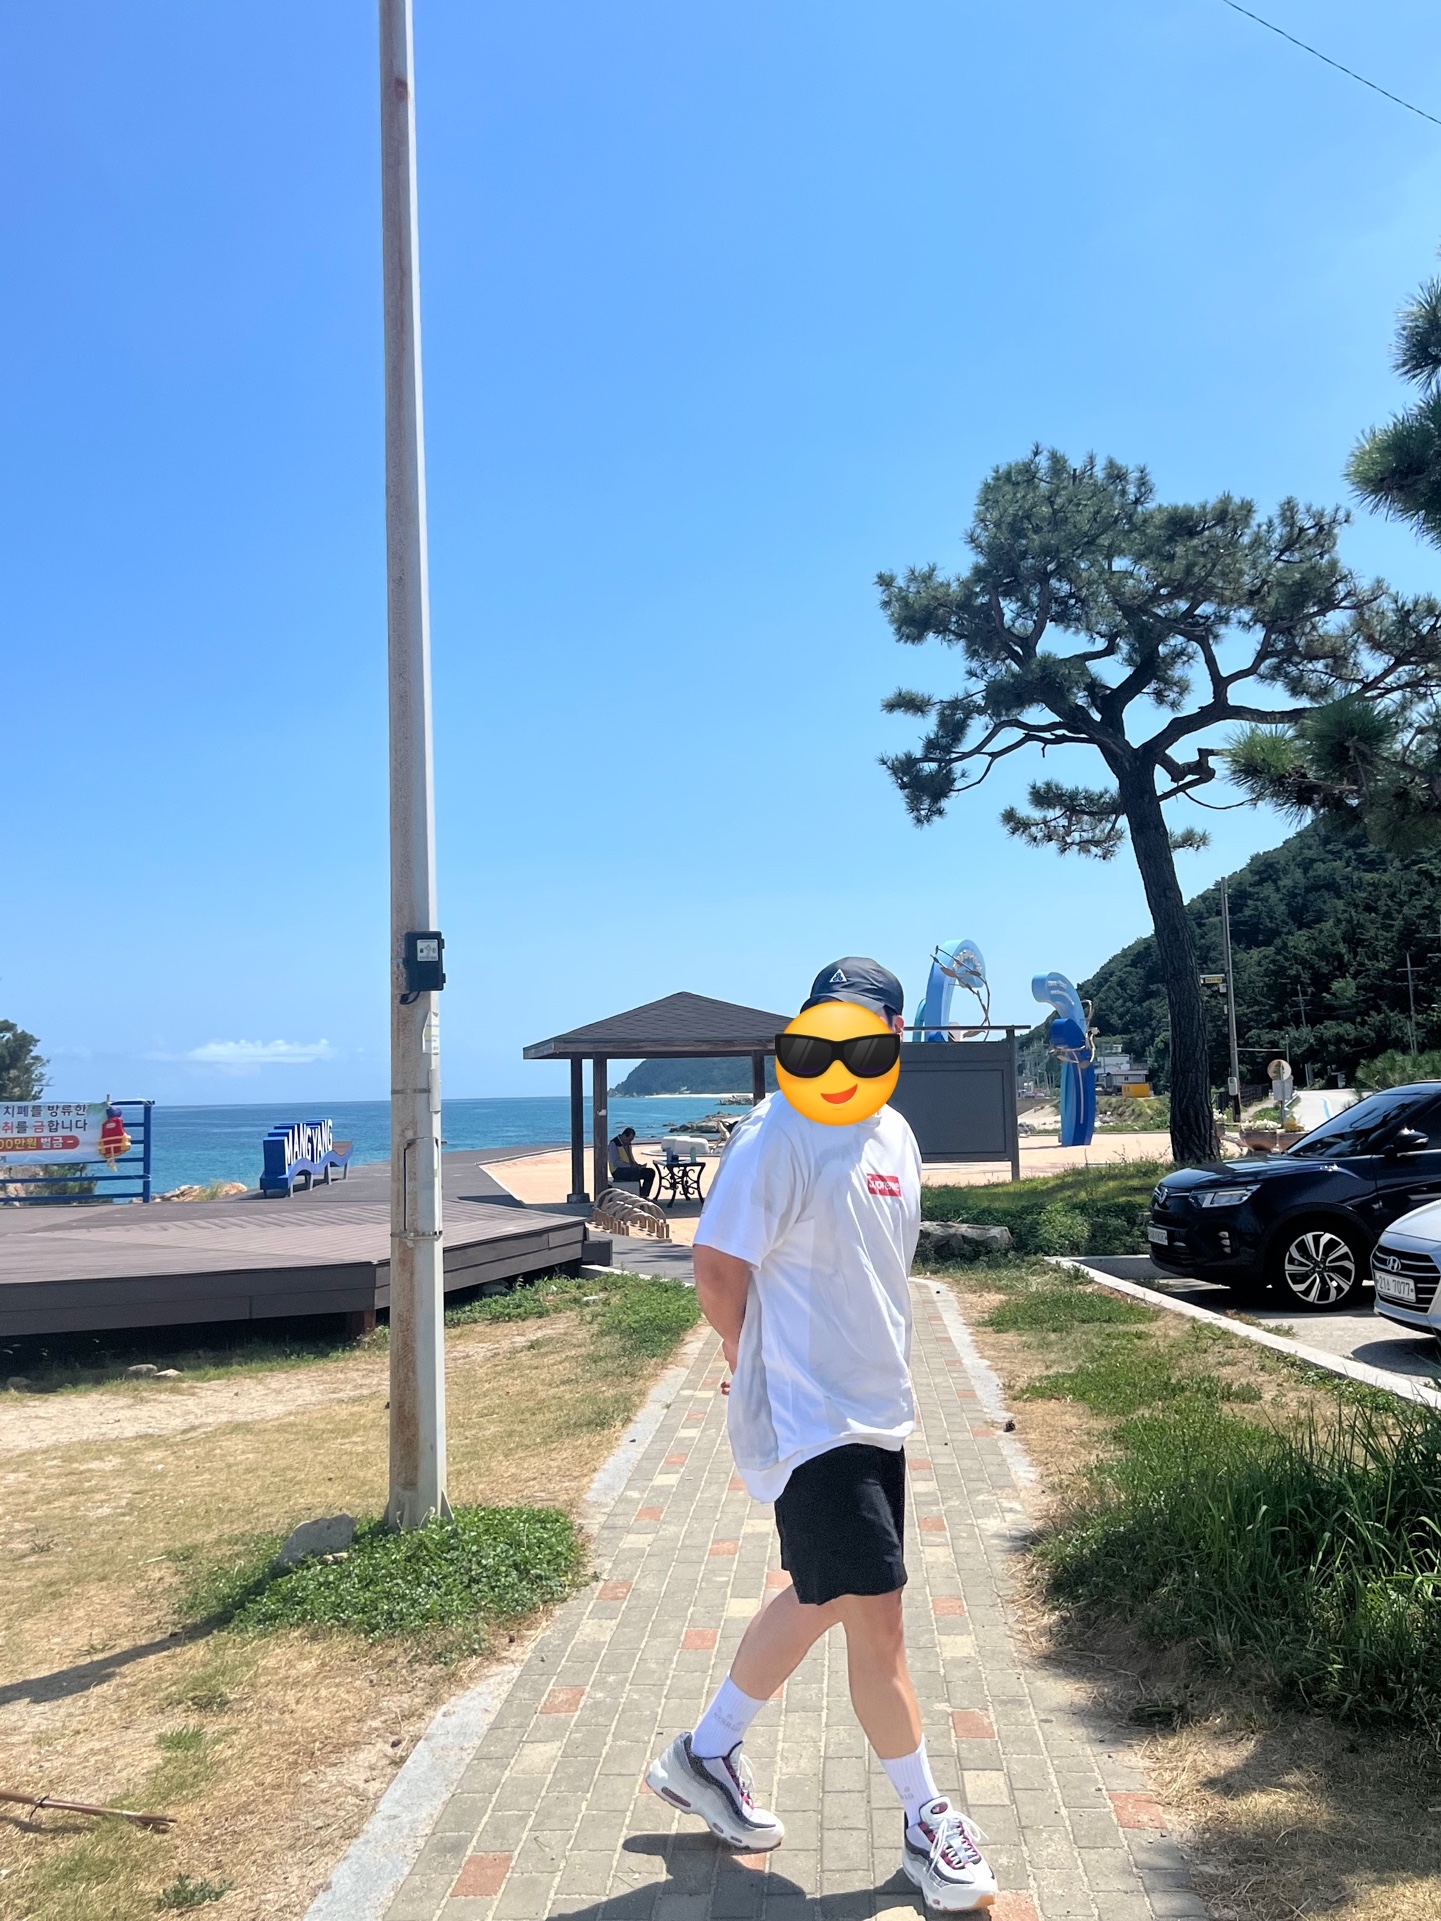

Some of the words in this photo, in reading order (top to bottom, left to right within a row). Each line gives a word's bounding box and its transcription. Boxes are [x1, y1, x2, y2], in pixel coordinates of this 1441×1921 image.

[47, 1104, 87, 1117] 방류한
[33, 1119, 88, 1134] 금합니다
[41, 1137, 63, 1149] 벌금
[284, 1119, 333, 1175] MANGYANG
